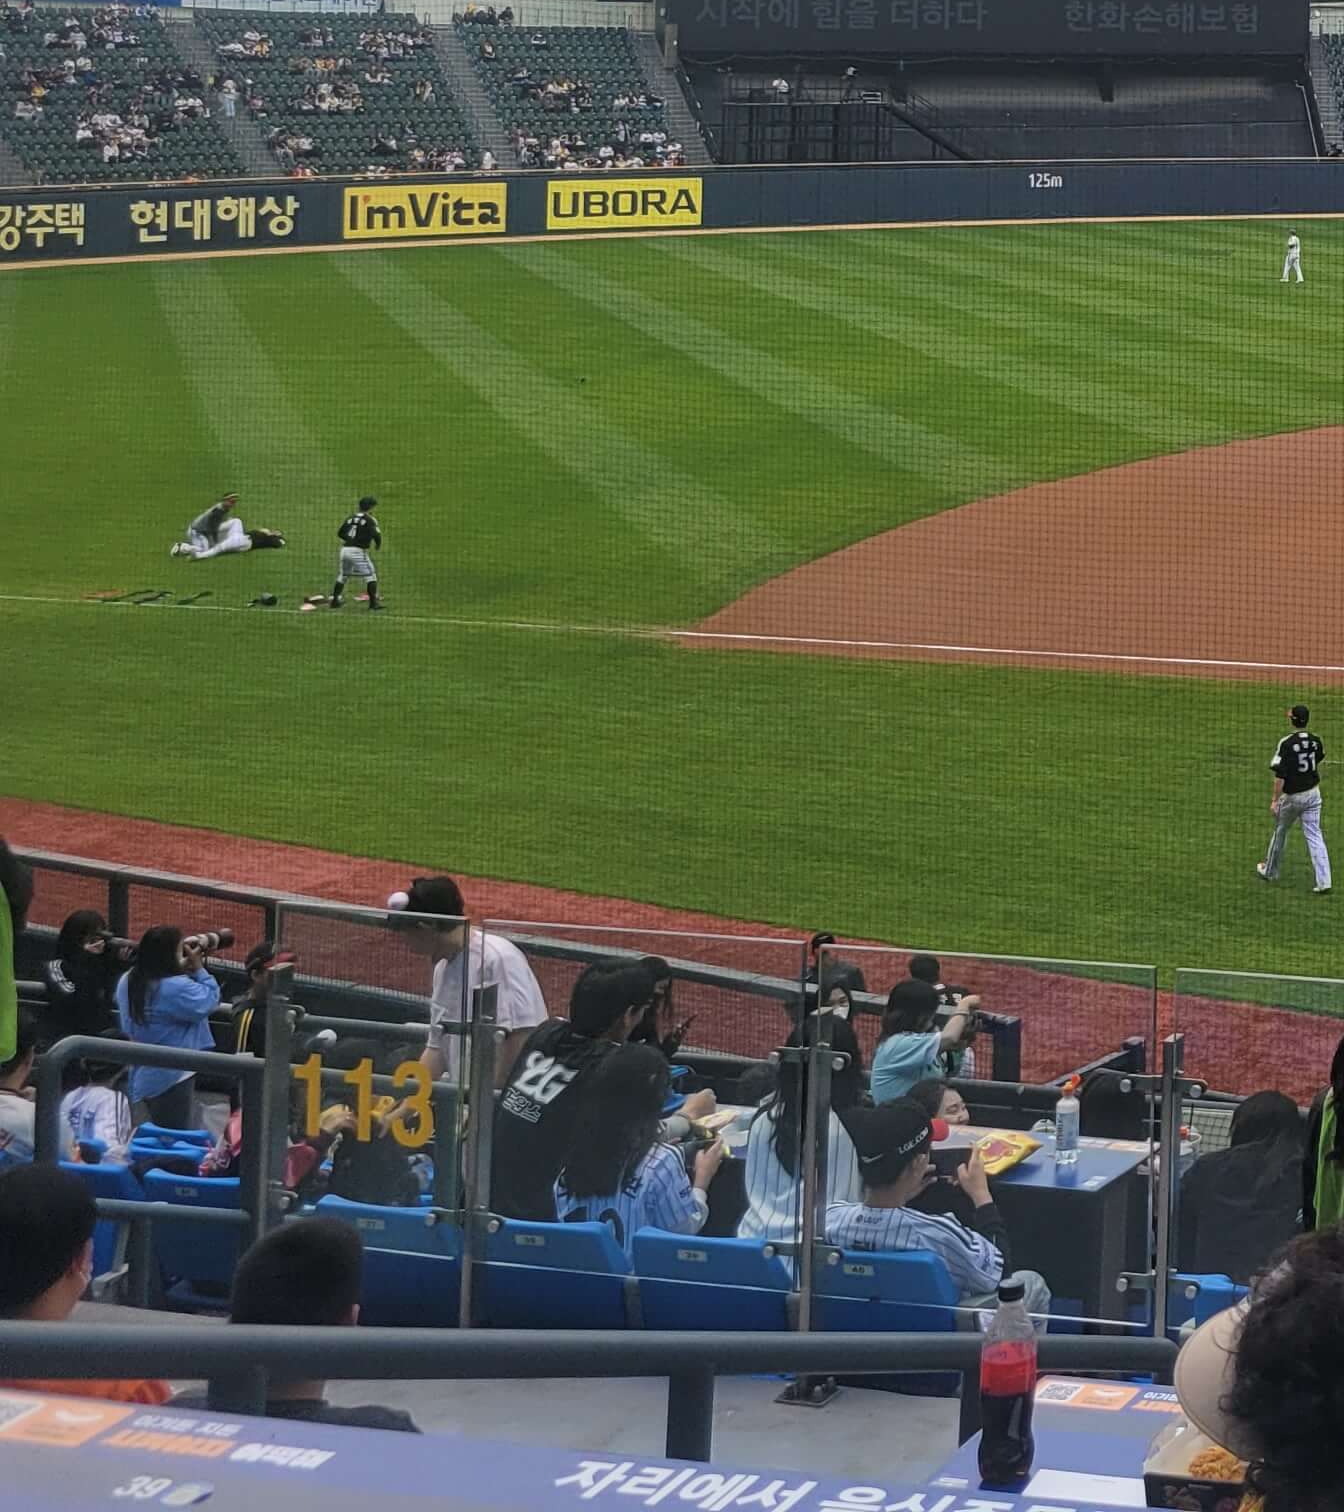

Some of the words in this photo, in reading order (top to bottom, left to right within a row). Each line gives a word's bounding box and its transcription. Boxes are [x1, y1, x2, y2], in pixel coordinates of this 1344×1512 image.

[1027, 172, 1063, 189] 125m
[128, 194, 301, 244] 현대해상
[552, 187, 699, 220] UBORA
[1297, 750, 1317, 773] 51
[294, 1053, 436, 1149] 113
[111, 1474, 173, 1500] 39
[555, 1457, 818, 1512] 자리에서
